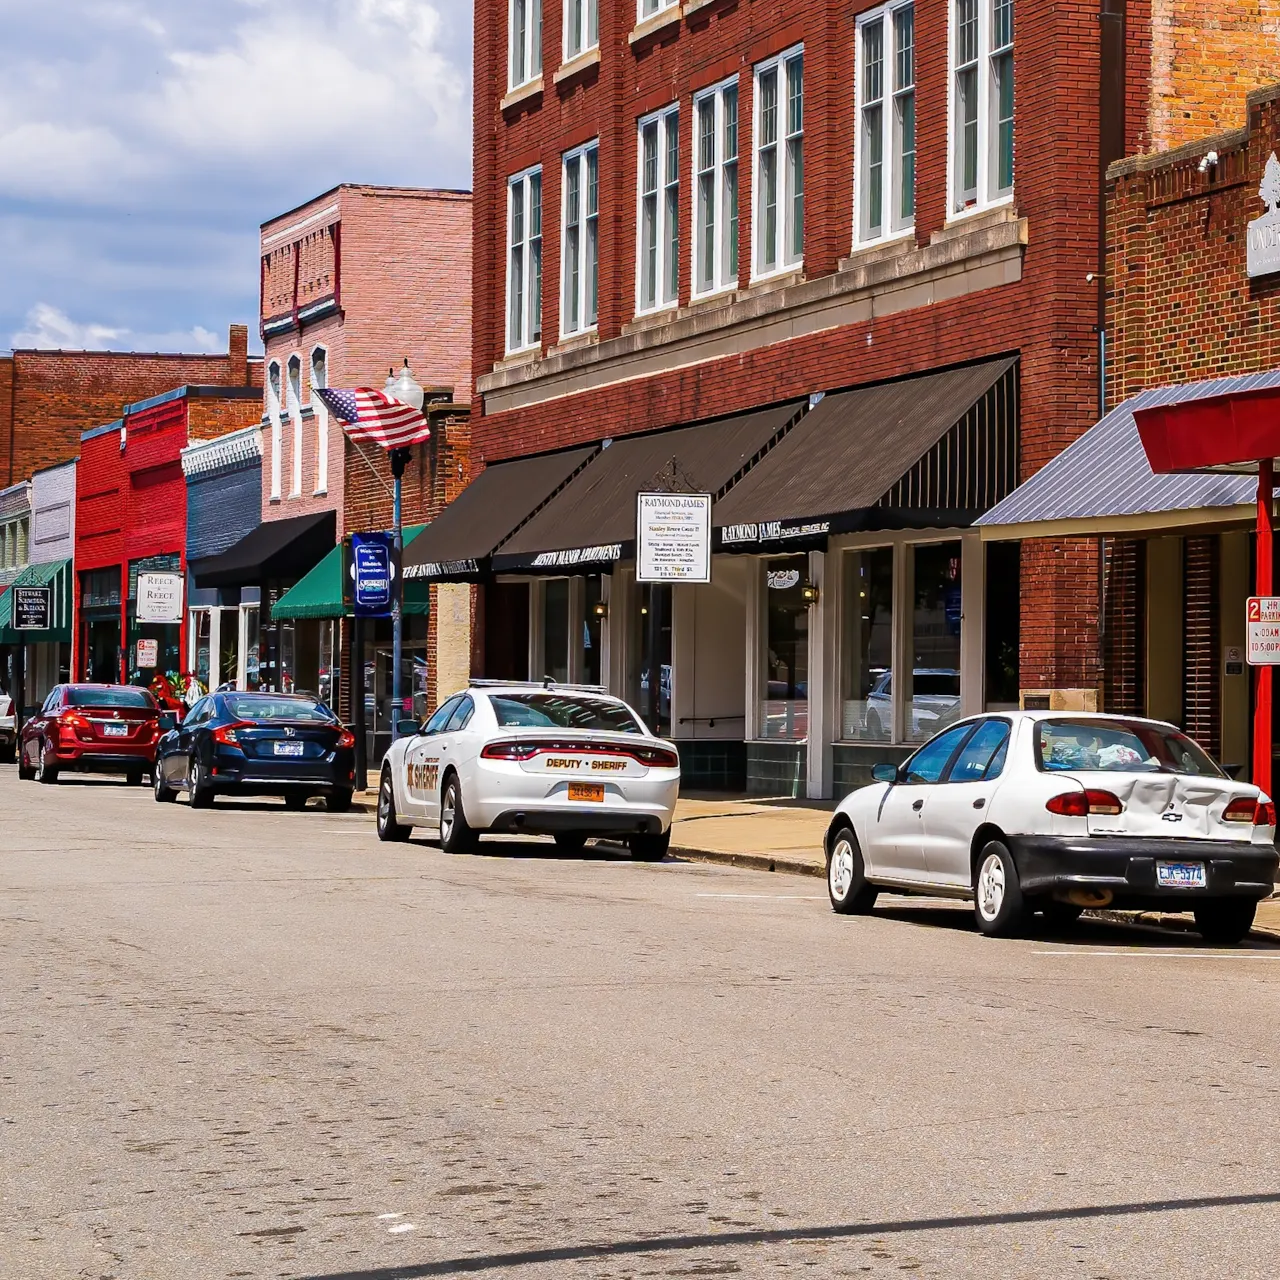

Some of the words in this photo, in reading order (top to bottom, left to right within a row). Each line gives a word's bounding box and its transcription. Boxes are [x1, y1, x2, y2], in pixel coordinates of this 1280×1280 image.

[645, 498, 681, 508] RAYMOND
[681, 499, 705, 509] JAMES
[721, 523, 758, 543] RAYMOND
[758, 521, 782, 543] JAMES
[147, 576, 175, 585] REECE
[147, 590, 175, 600] REECE
[1249, 602, 1259, 619] 2
[1267, 601, 1278, 610] HR
[545, 758, 583, 770] DEPUTY
[591, 760, 628, 772] SHERIFF
[414, 764, 439, 791] SHERIFF
